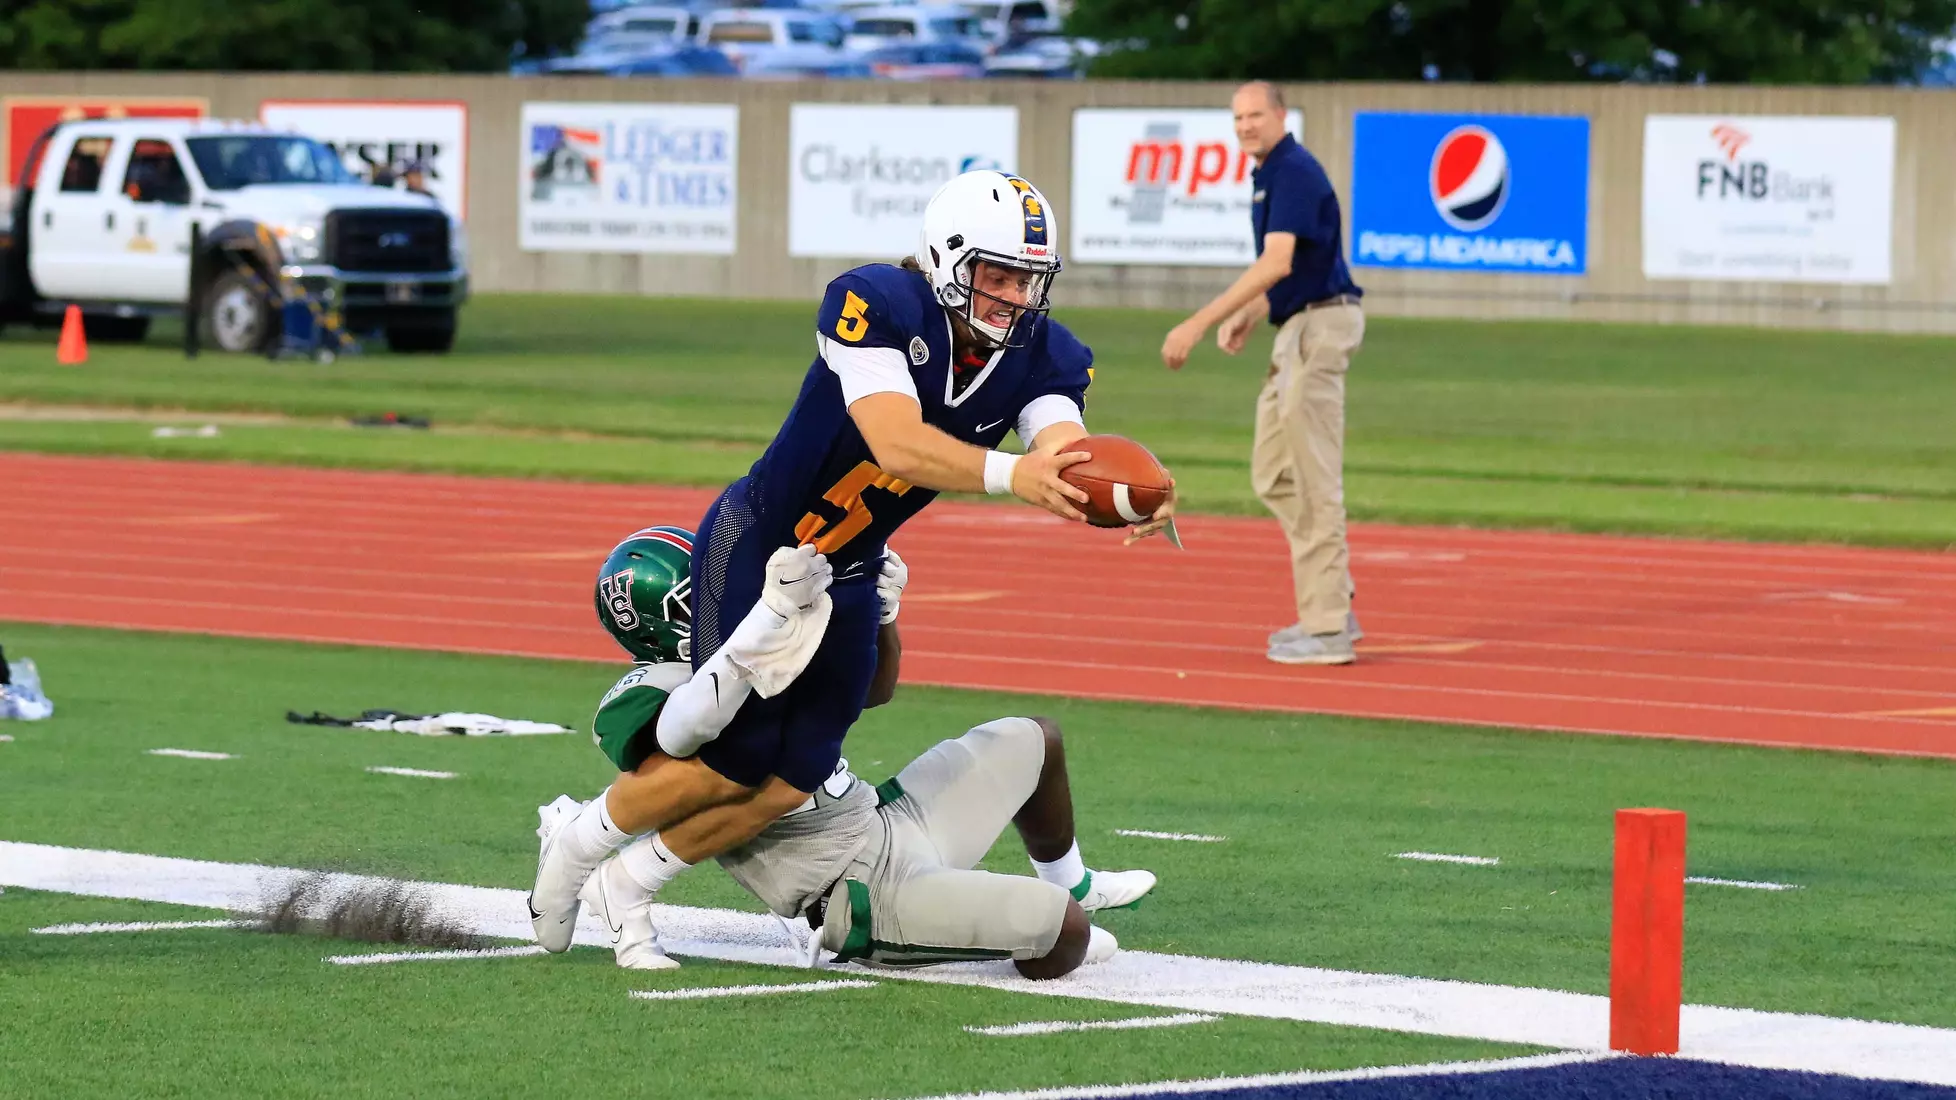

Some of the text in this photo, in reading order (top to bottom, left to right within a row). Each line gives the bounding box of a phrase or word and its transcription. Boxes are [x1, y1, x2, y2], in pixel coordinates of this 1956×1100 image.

[604, 119, 729, 165] LEDGER
[800, 143, 950, 184] Clarkson
[633, 164, 729, 209] TIMES
[1696, 159, 1836, 201] FNB Bank
[1358, 230, 1427, 263] PEPSI
[835, 290, 870, 343] 5
[794, 459, 914, 555] 5
